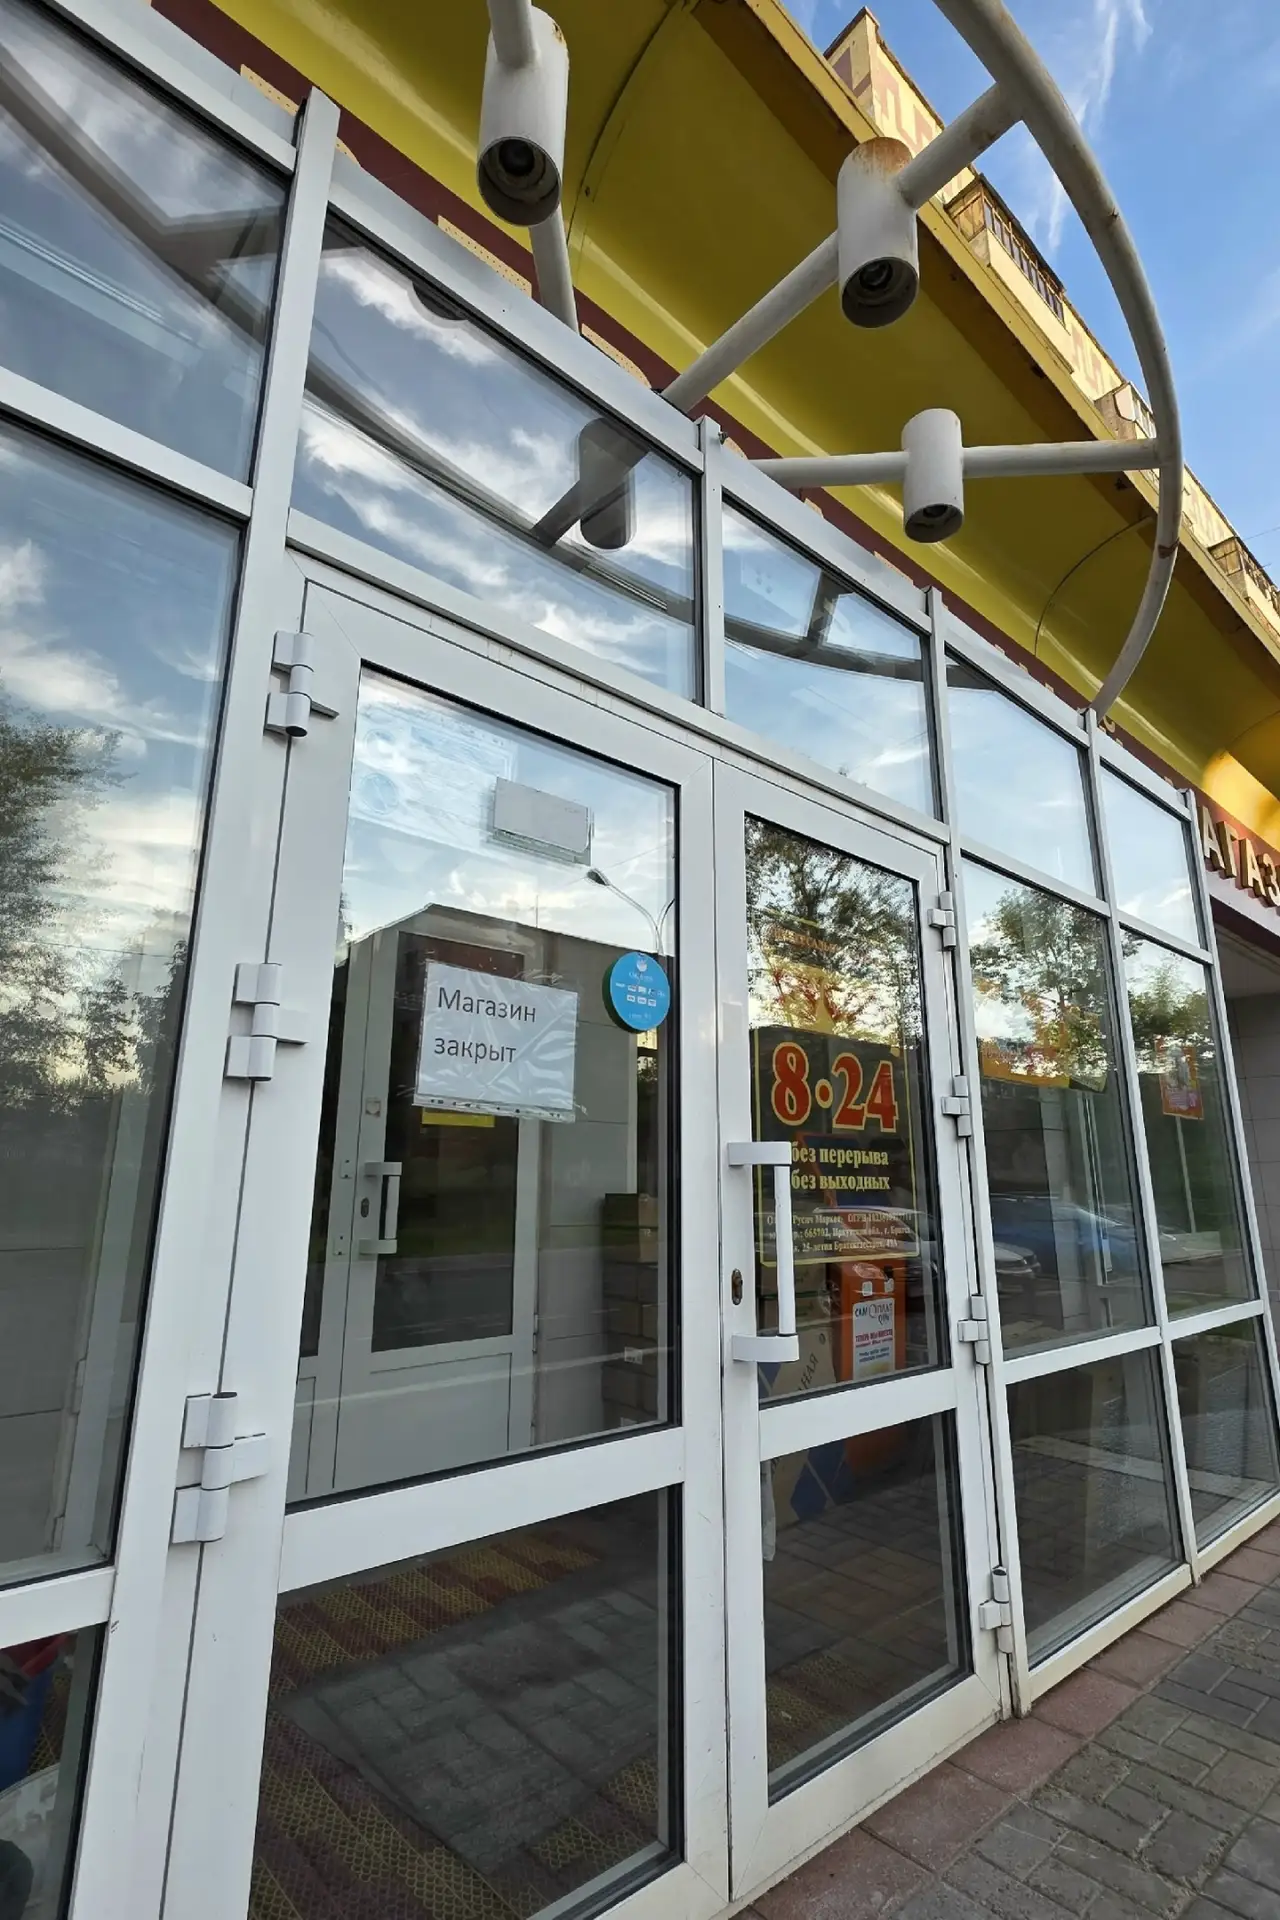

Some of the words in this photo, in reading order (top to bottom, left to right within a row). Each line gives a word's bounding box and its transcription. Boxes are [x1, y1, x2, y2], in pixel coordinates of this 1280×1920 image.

[437, 985, 537, 1023] Магазин
[433, 1037, 517, 1065] закрыт
[791, 1141, 816, 1163] без
[819, 1147, 889, 1168] перерыва
[791, 1169, 816, 1190] без
[819, 1175, 890, 1192] выходных
